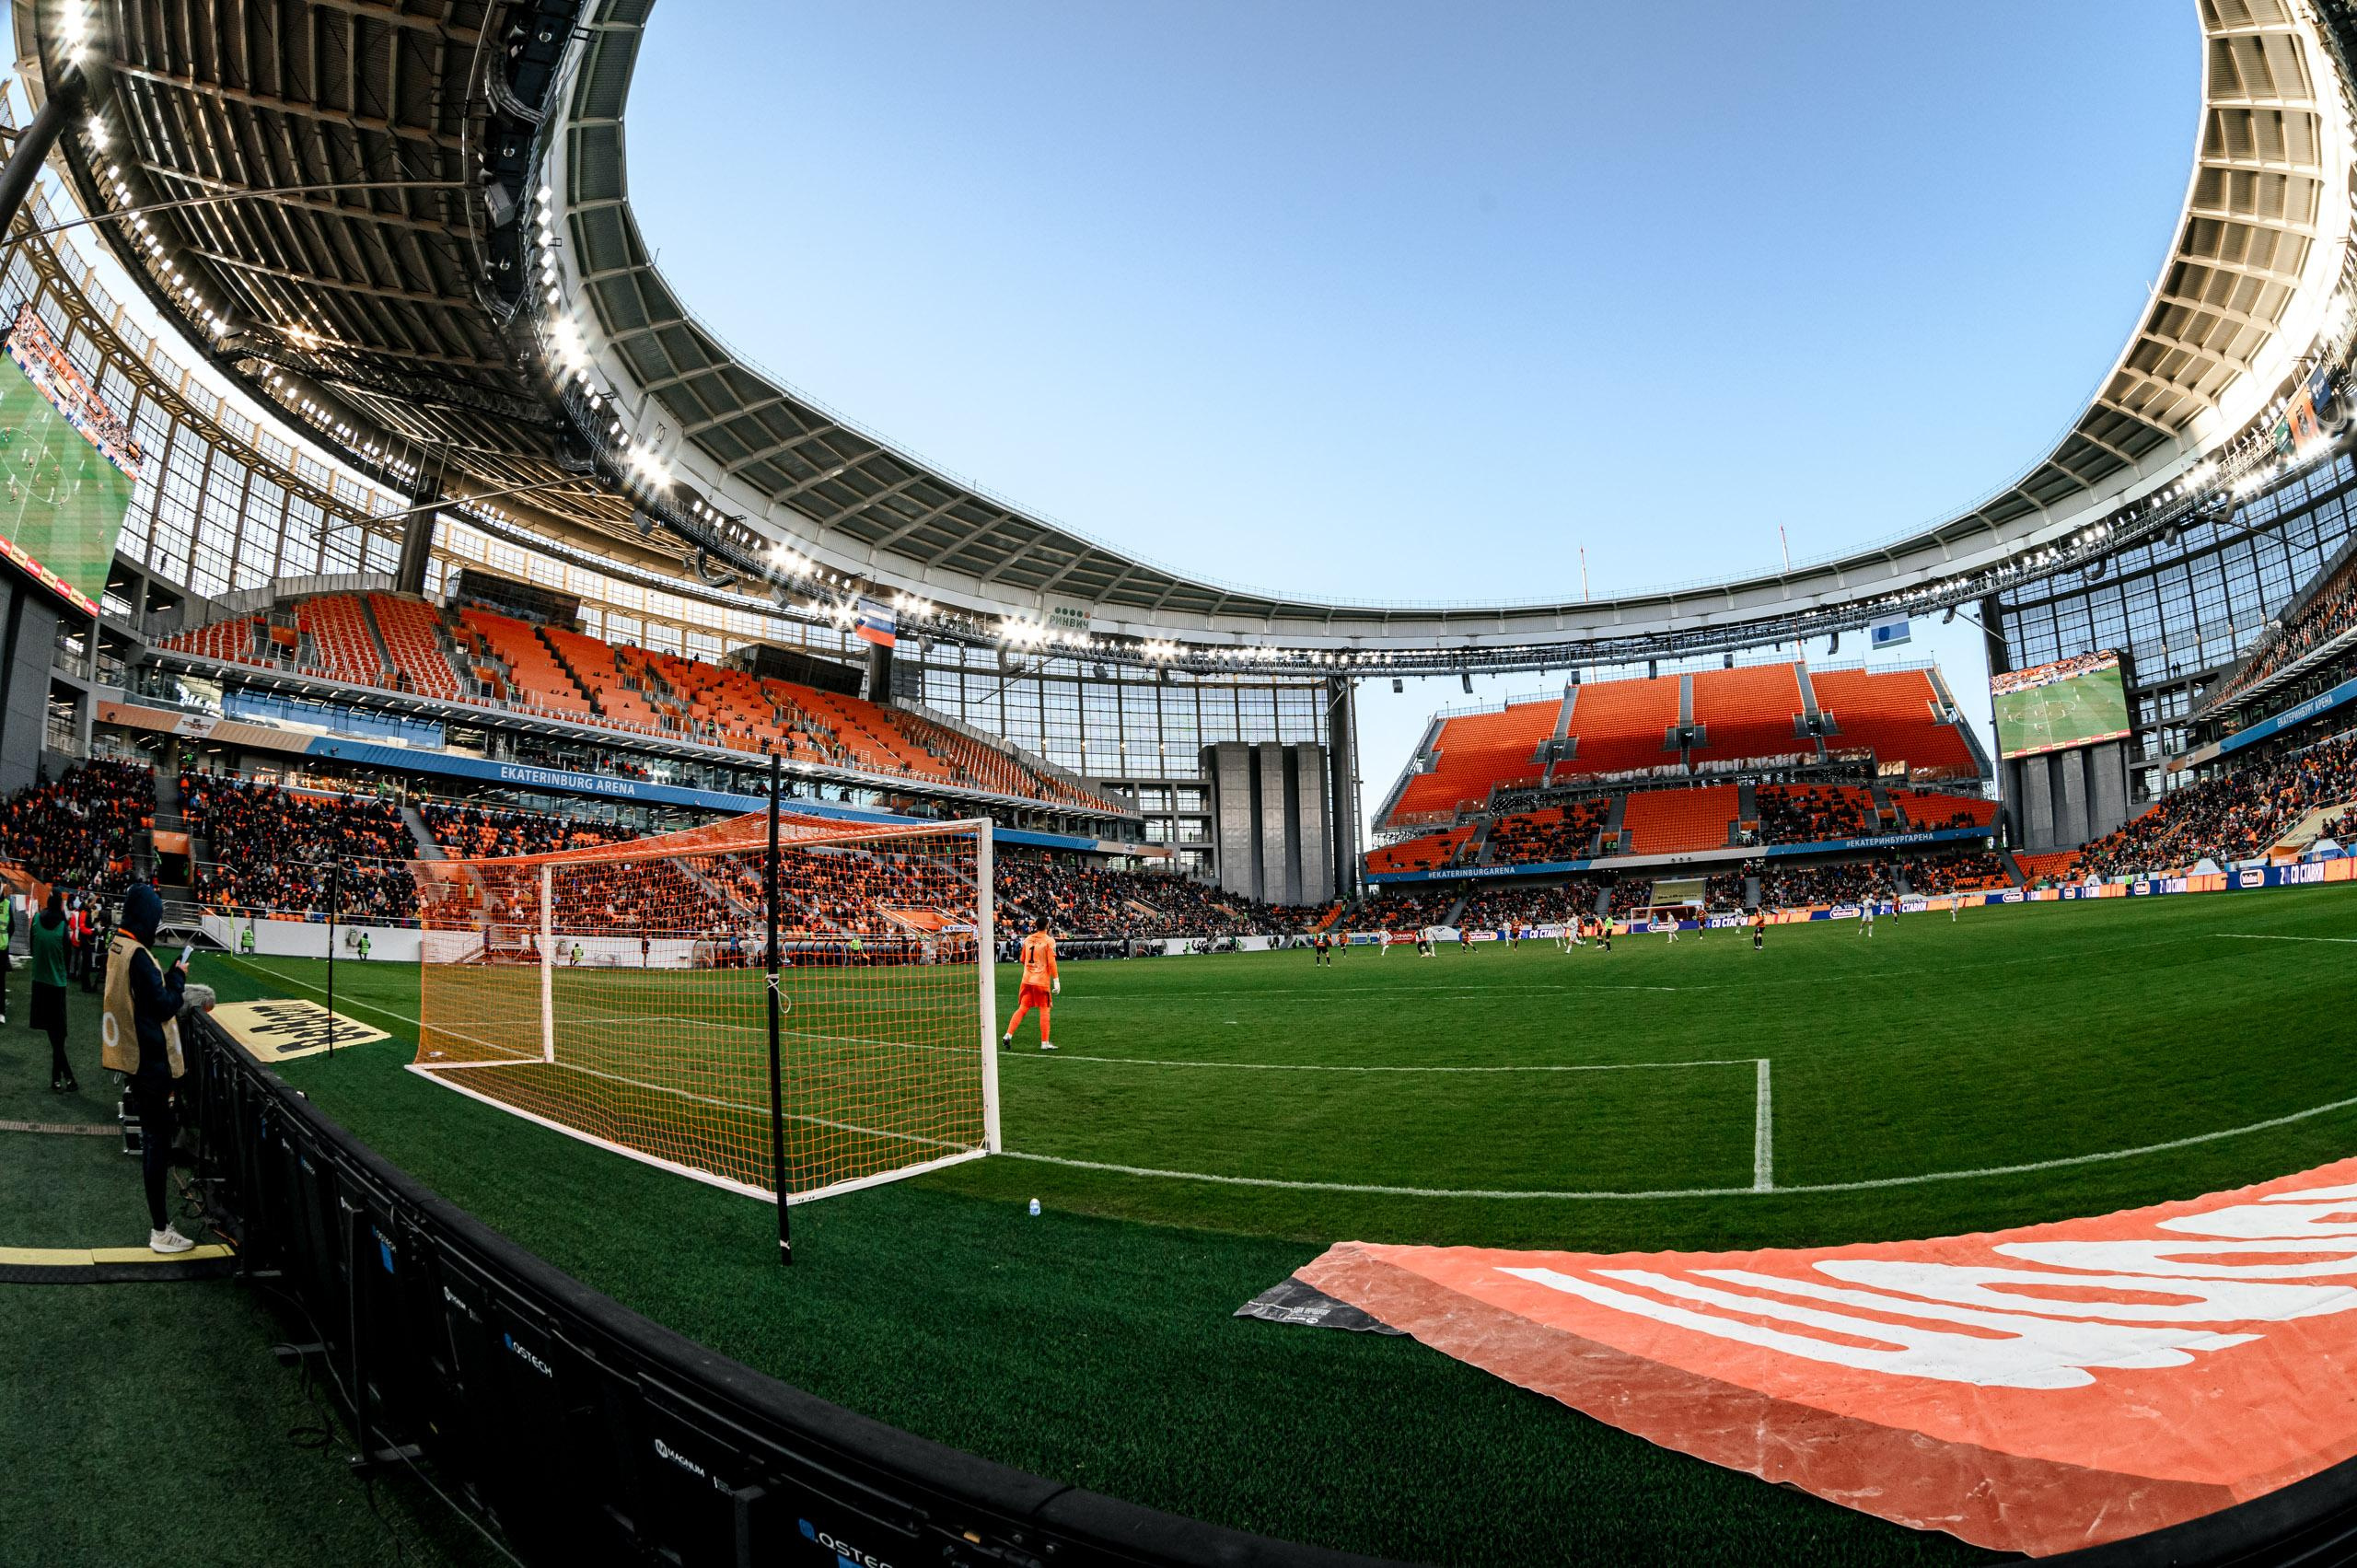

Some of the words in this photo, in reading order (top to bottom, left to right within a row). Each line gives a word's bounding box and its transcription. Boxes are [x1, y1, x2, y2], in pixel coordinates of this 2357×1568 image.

[1047, 614, 1090, 630] РИНВИЧ
[2277, 703, 2315, 728] ЕКАТЕРИНБУРГ
[2315, 694, 2334, 711] АРЕНА
[500, 766, 593, 790] EKATERINBURG
[596, 780, 635, 795] ARENA
[1846, 832, 1933, 847] #ЕКАТЕРИНБУРГАРЕНА
[1428, 866, 1515, 878] #EKATERINBURGARENA
[1028, 946, 1035, 963] 1
[667, 1447, 706, 1478] MAGNUM
